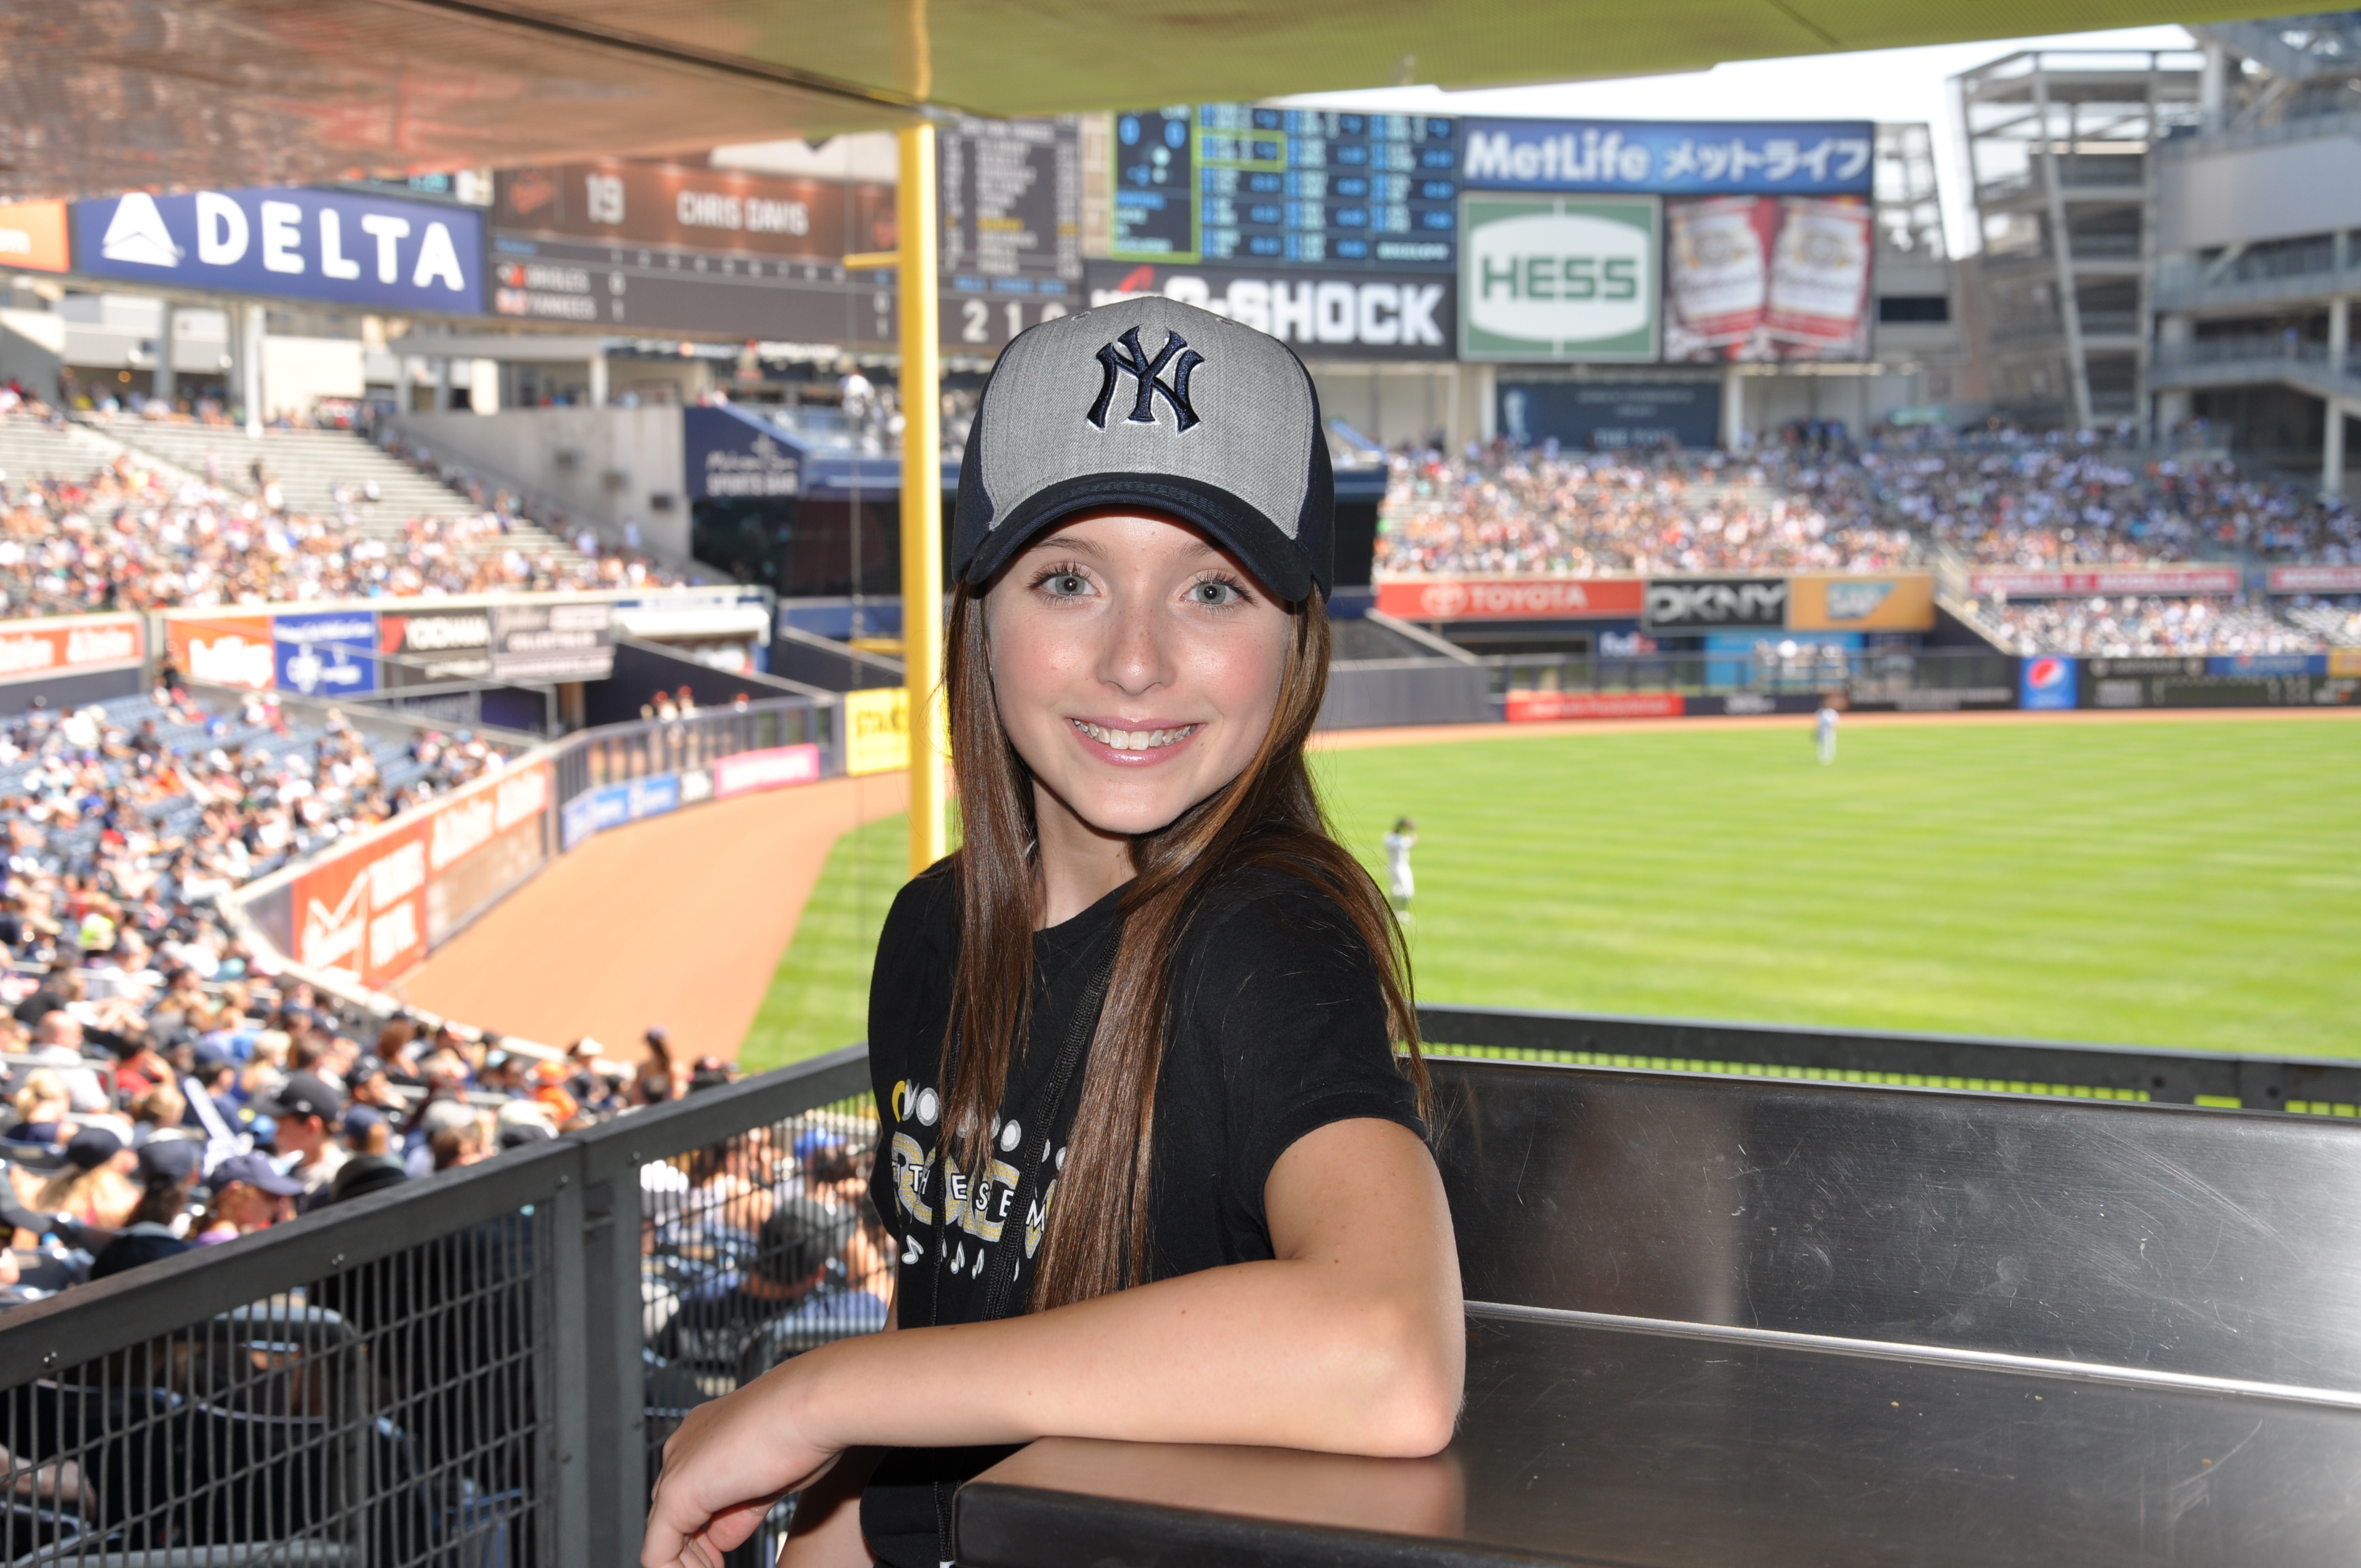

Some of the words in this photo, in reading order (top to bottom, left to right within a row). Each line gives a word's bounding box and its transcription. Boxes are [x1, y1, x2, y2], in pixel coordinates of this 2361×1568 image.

[1464, 129, 1650, 180] MetLife
[1662, 138, 1870, 181] メットライフ
[585, 173, 626, 224] 19
[677, 189, 742, 230] CHRIS
[745, 197, 809, 236] DAVIS
[195, 190, 465, 292] DELTA
[1481, 255, 1639, 301] HESS
[962, 298, 989, 343] 2
[1003, 298, 1023, 341] 1
[1086, 325, 1205, 437] NY
[1470, 582, 1589, 612] TOYOTA
[1648, 584, 1788, 622] DKNY
